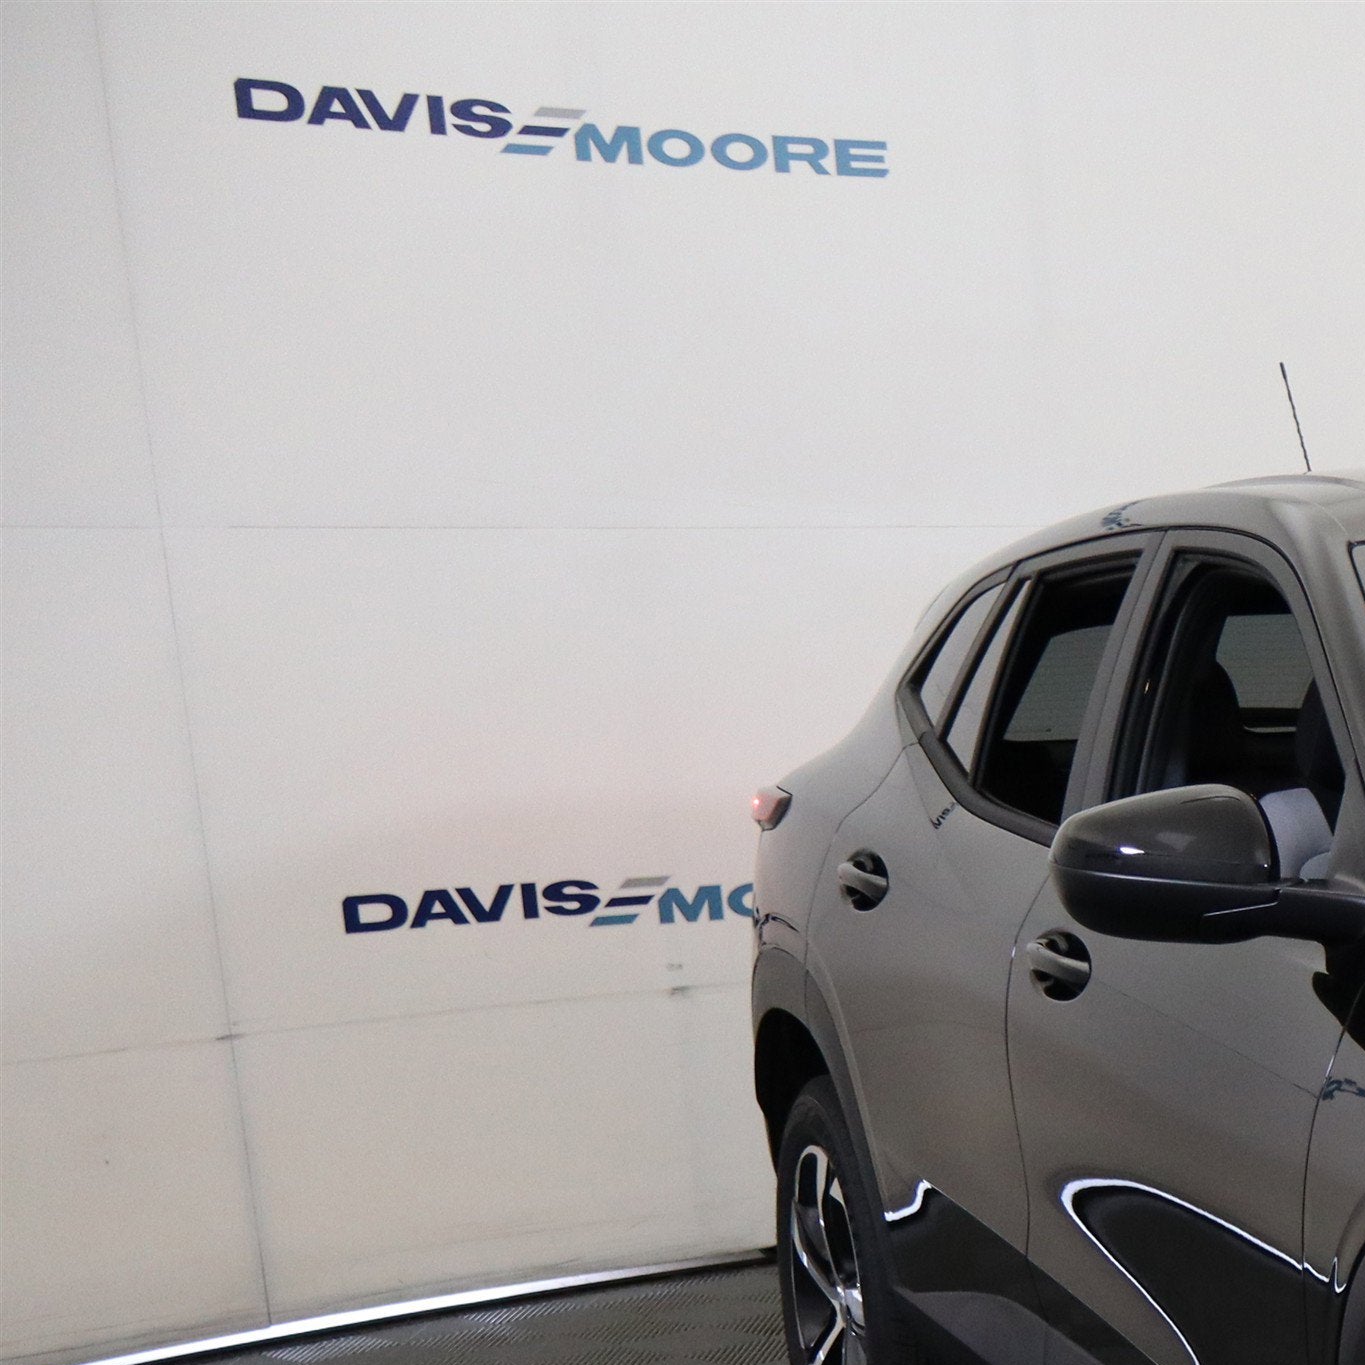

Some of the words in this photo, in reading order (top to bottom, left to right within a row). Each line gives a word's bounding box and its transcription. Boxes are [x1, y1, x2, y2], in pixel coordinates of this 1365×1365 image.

[235, 77, 514, 140] DAVIS
[574, 122, 890, 178] MOORE
[343, 880, 602, 935] DAVIS
